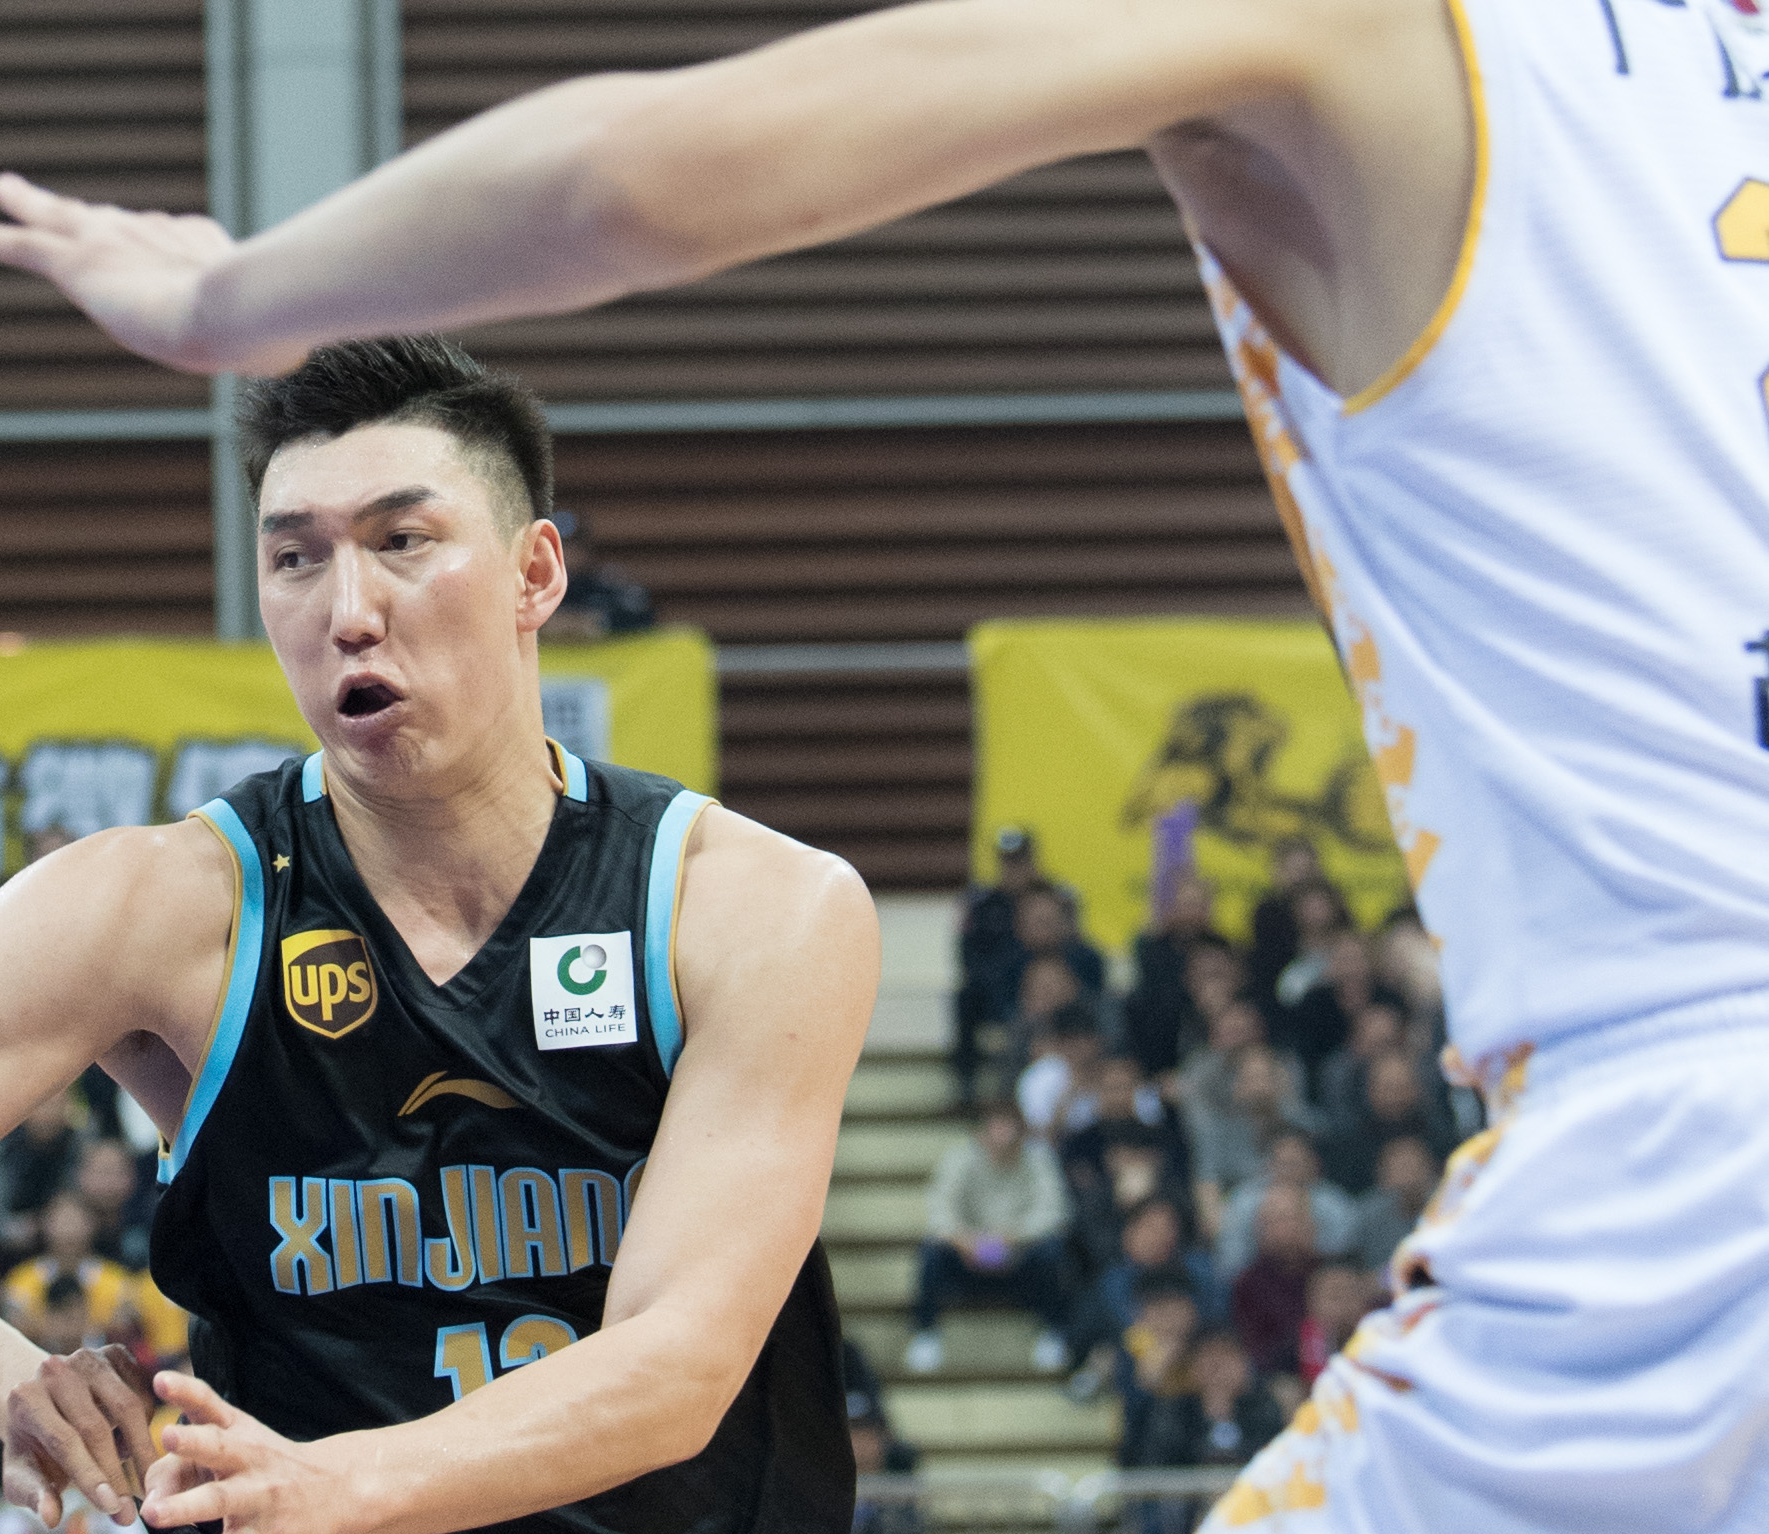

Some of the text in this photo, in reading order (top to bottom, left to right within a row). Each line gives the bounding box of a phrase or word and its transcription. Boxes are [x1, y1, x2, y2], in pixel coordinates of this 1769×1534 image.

[543, 1004, 626, 1025] 中国人寿
[545, 1023, 626, 1038] CHINA LIFE
[268, 1157, 647, 1297] XINJIAN
